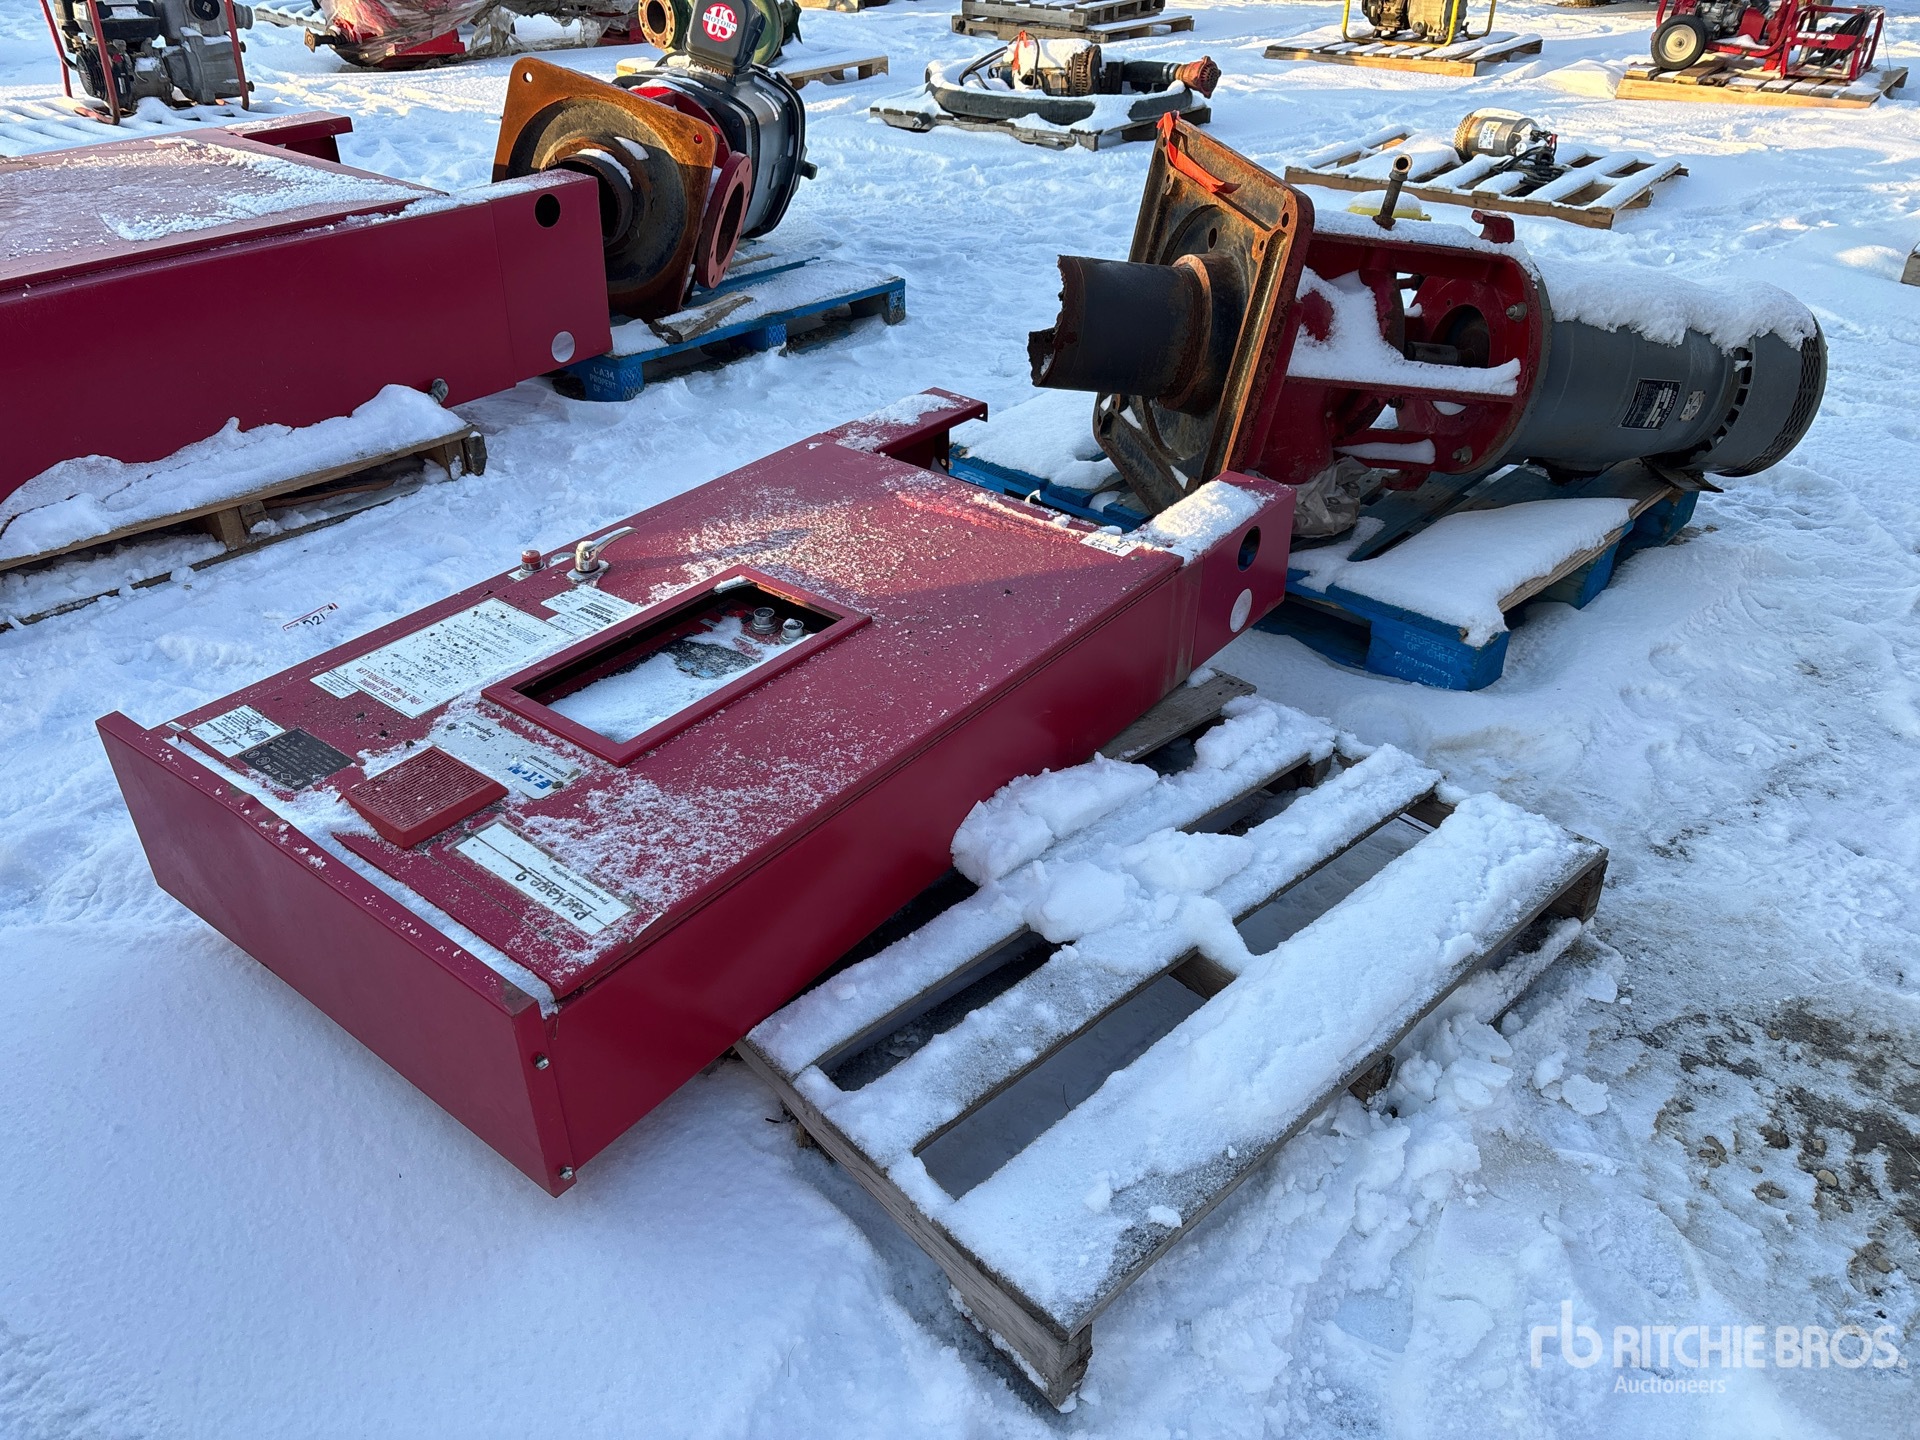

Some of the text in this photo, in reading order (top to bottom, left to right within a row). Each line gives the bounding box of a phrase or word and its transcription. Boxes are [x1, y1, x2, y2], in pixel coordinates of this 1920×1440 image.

[704, 14, 736, 30] MOTORS
[707, 6, 735, 38] US
[1661, 390, 1677, 422] RANDOLPH
[576, 606, 612, 624] National
[1407, 642, 1421, 653] OF
[356, 666, 394, 688] CONTROLLER
[358, 678, 382, 692] ENGINE
[380, 690, 401, 702] DIESEL
[390, 687, 411, 698] PUMP
[406, 695, 424, 705] FIRE
[514, 868, 591, 920] Package 9
